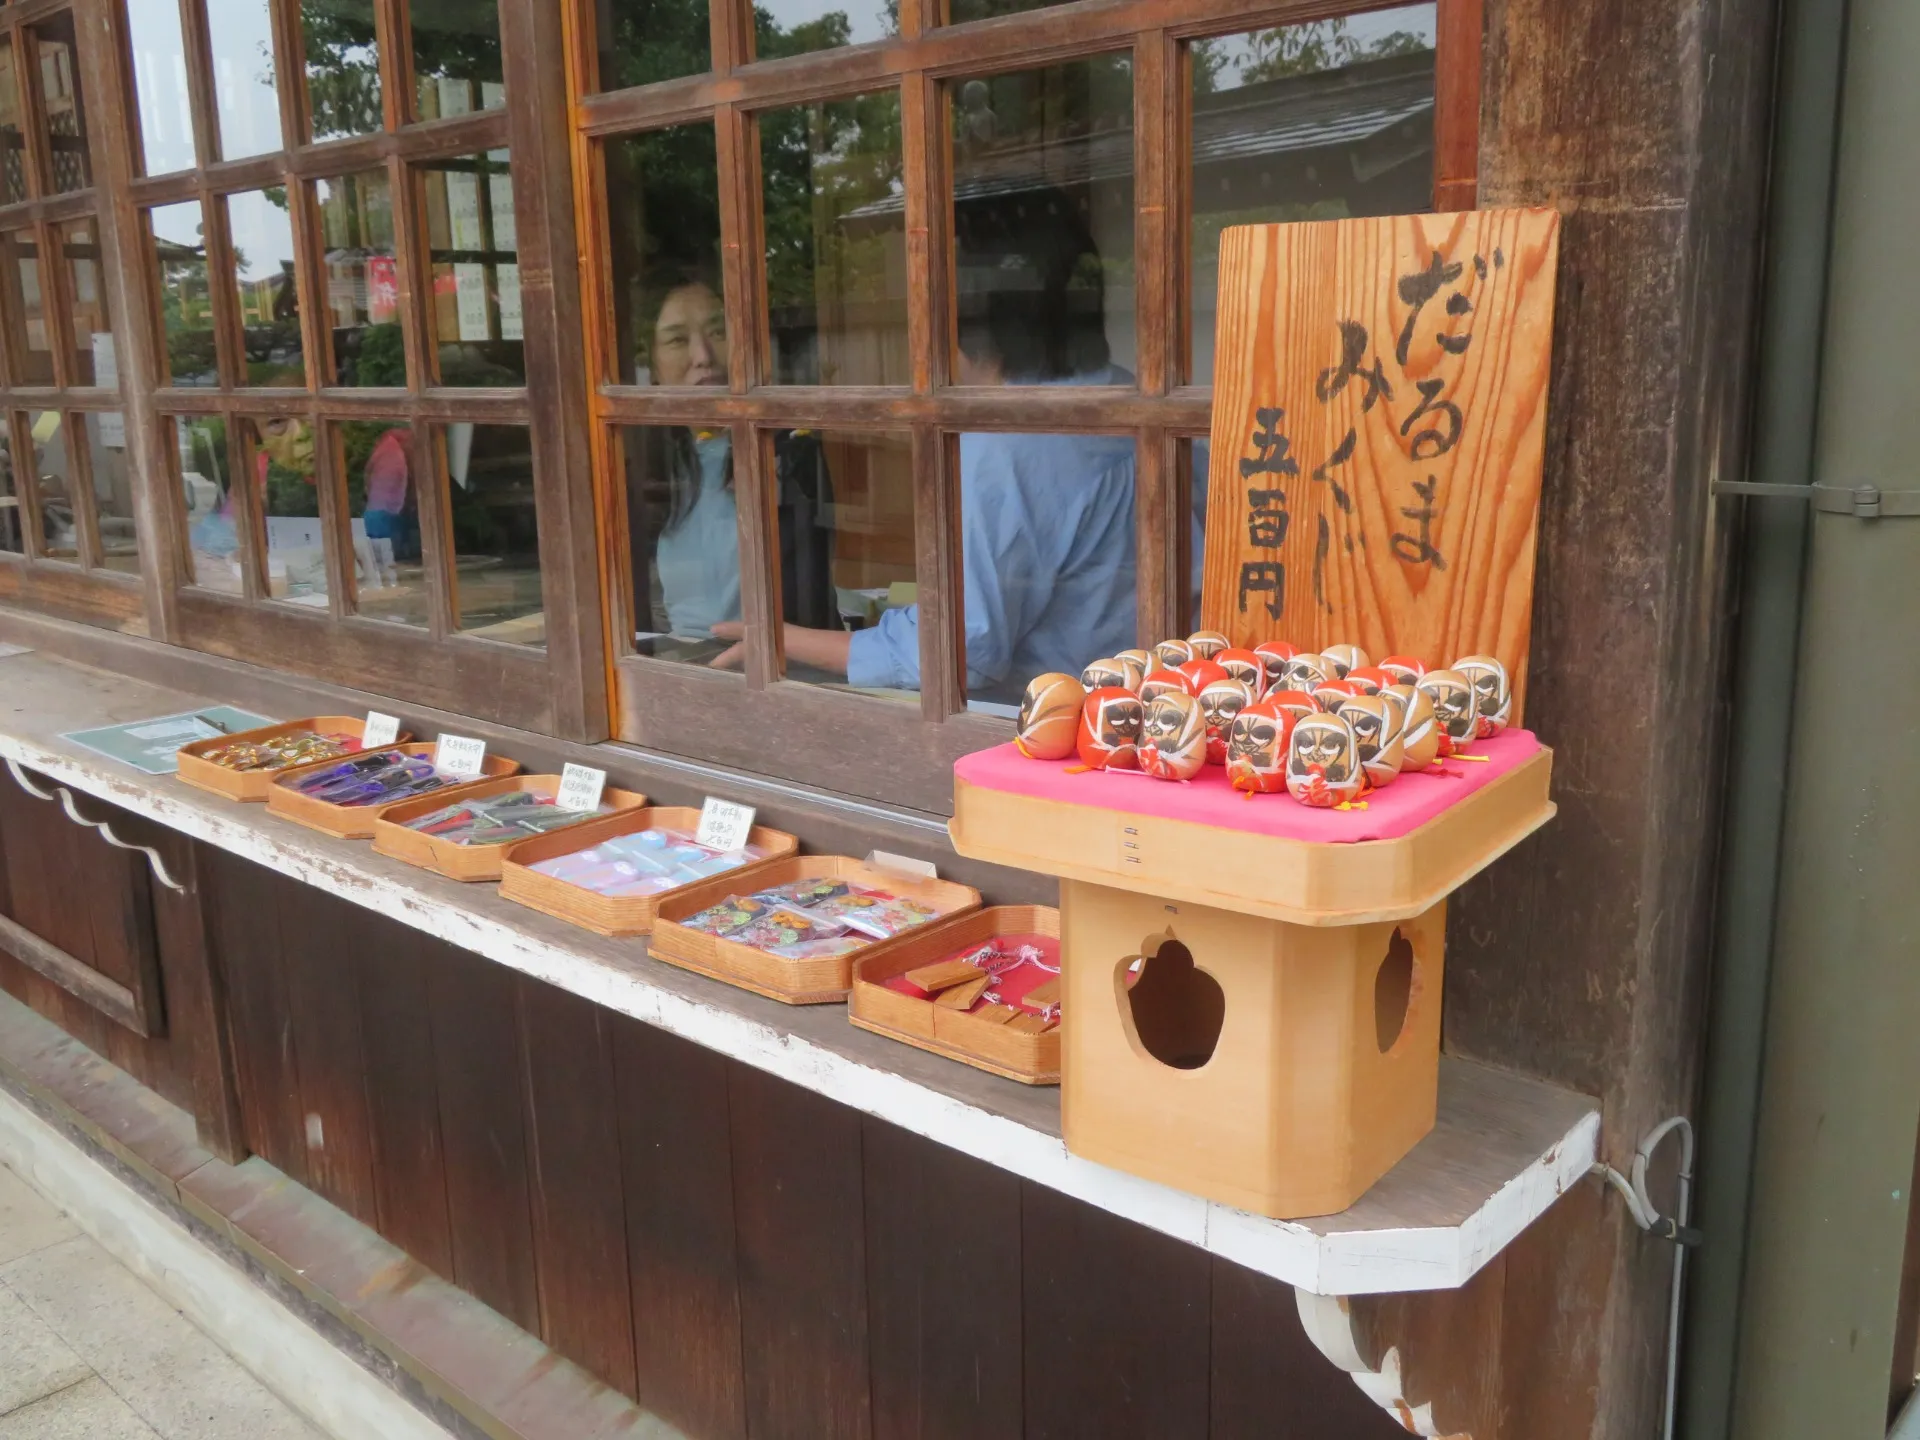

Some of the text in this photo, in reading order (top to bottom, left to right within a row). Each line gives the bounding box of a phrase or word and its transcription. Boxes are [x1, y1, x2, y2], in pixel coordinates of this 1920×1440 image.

[1239, 406, 1299, 621] 五百円
[1313, 318, 1393, 615] みくじ
[1390, 246, 1504, 570] だるま
